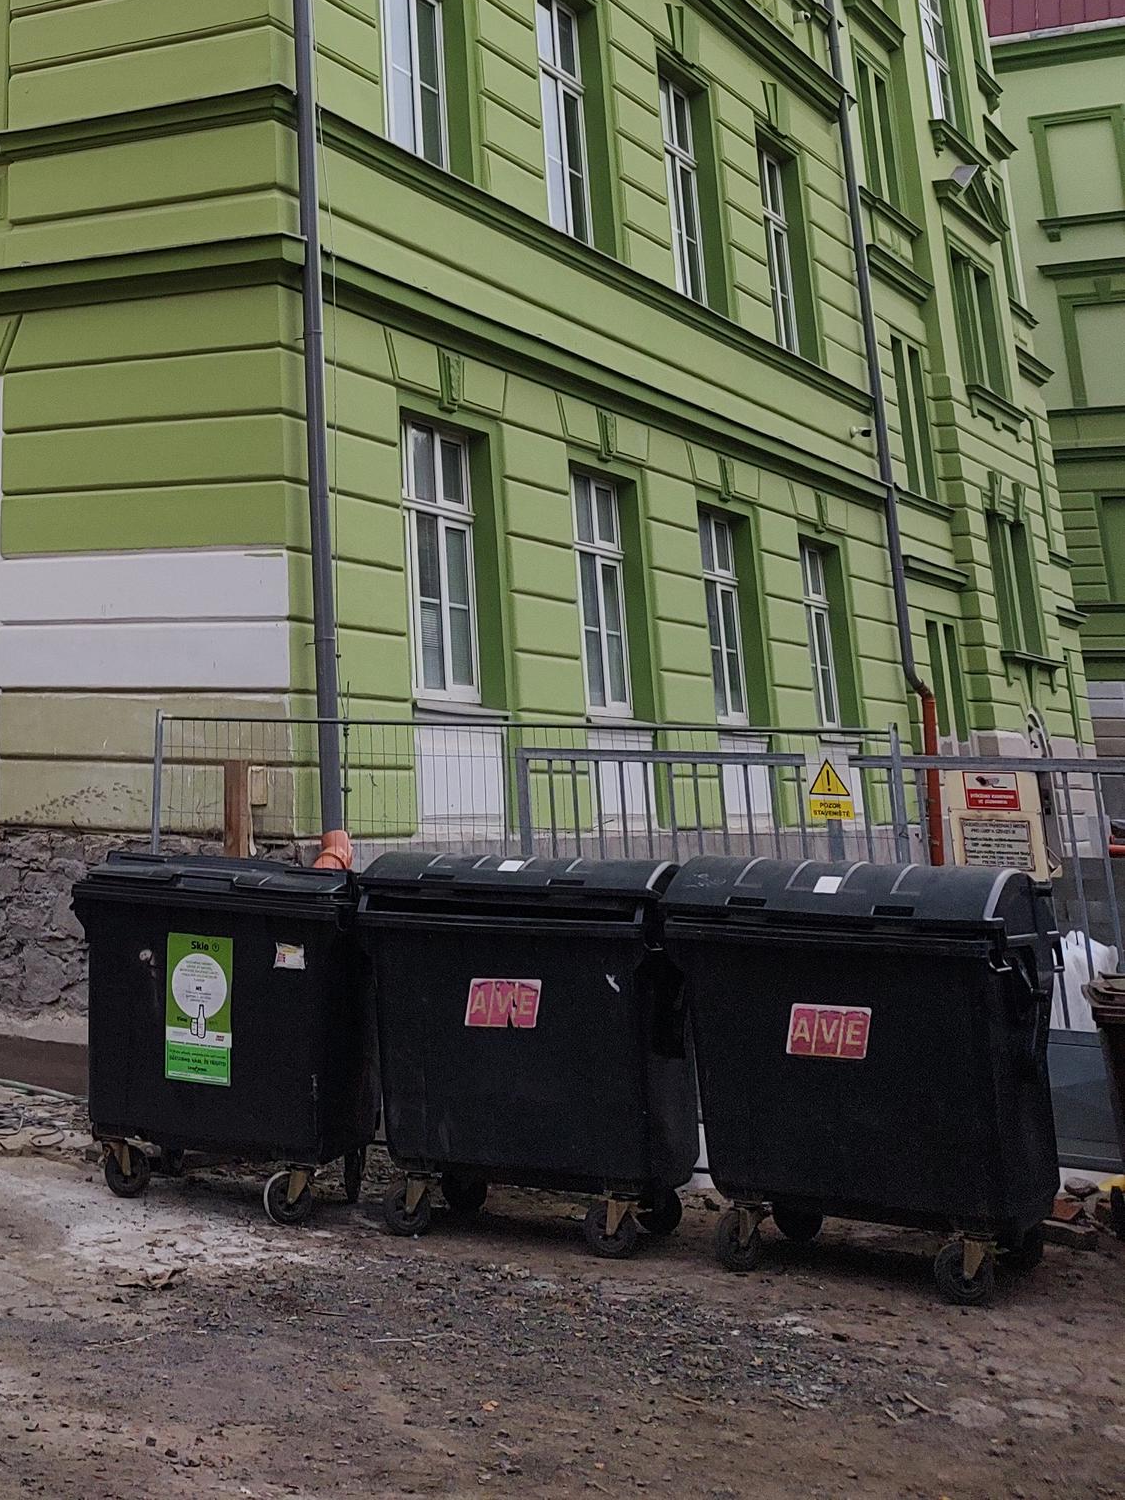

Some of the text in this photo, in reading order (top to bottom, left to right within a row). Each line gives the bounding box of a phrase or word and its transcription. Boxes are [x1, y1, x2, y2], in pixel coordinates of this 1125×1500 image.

[191, 940, 209, 951] Sklo
[470, 990, 537, 1016] AVE
[792, 1017, 865, 1045] AVE
